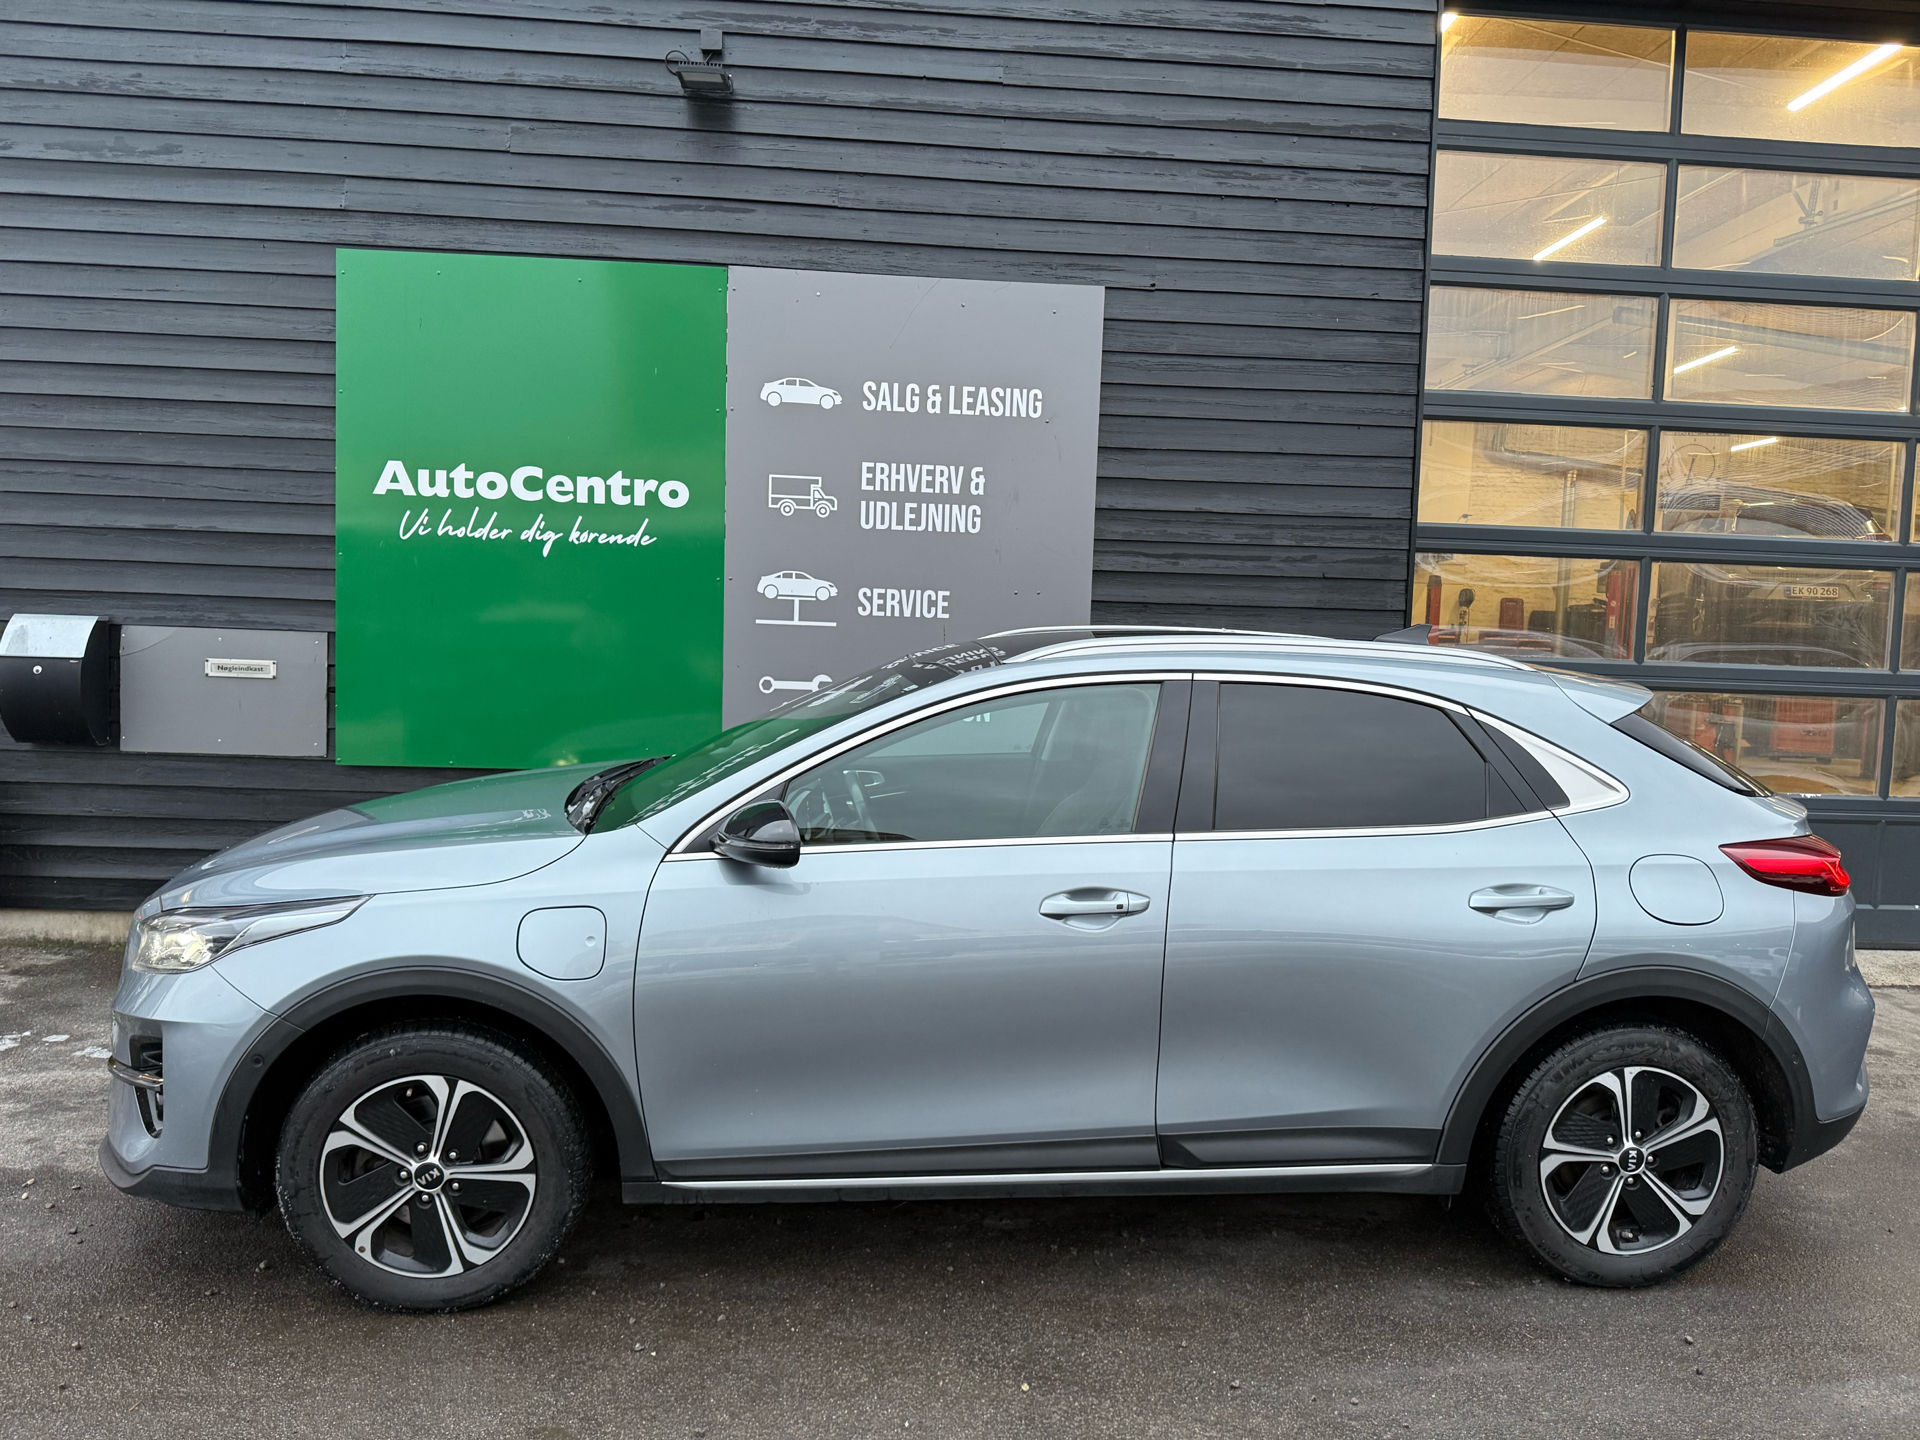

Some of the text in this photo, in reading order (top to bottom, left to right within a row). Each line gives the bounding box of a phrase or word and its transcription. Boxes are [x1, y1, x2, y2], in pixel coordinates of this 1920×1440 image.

[862, 380, 1043, 419] SALG & LEASING
[372, 459, 690, 509] AutoCentro
[861, 461, 986, 496] ERHVERV &
[399, 506, 659, 558] Vi holder dig kørende
[860, 500, 982, 534] UDLEJNING
[857, 587, 951, 619] SERVICE
[1792, 586, 1838, 596] EK 90 268
[416, 1167, 441, 1186] KIA
[1627, 1150, 1638, 1171] KIA
